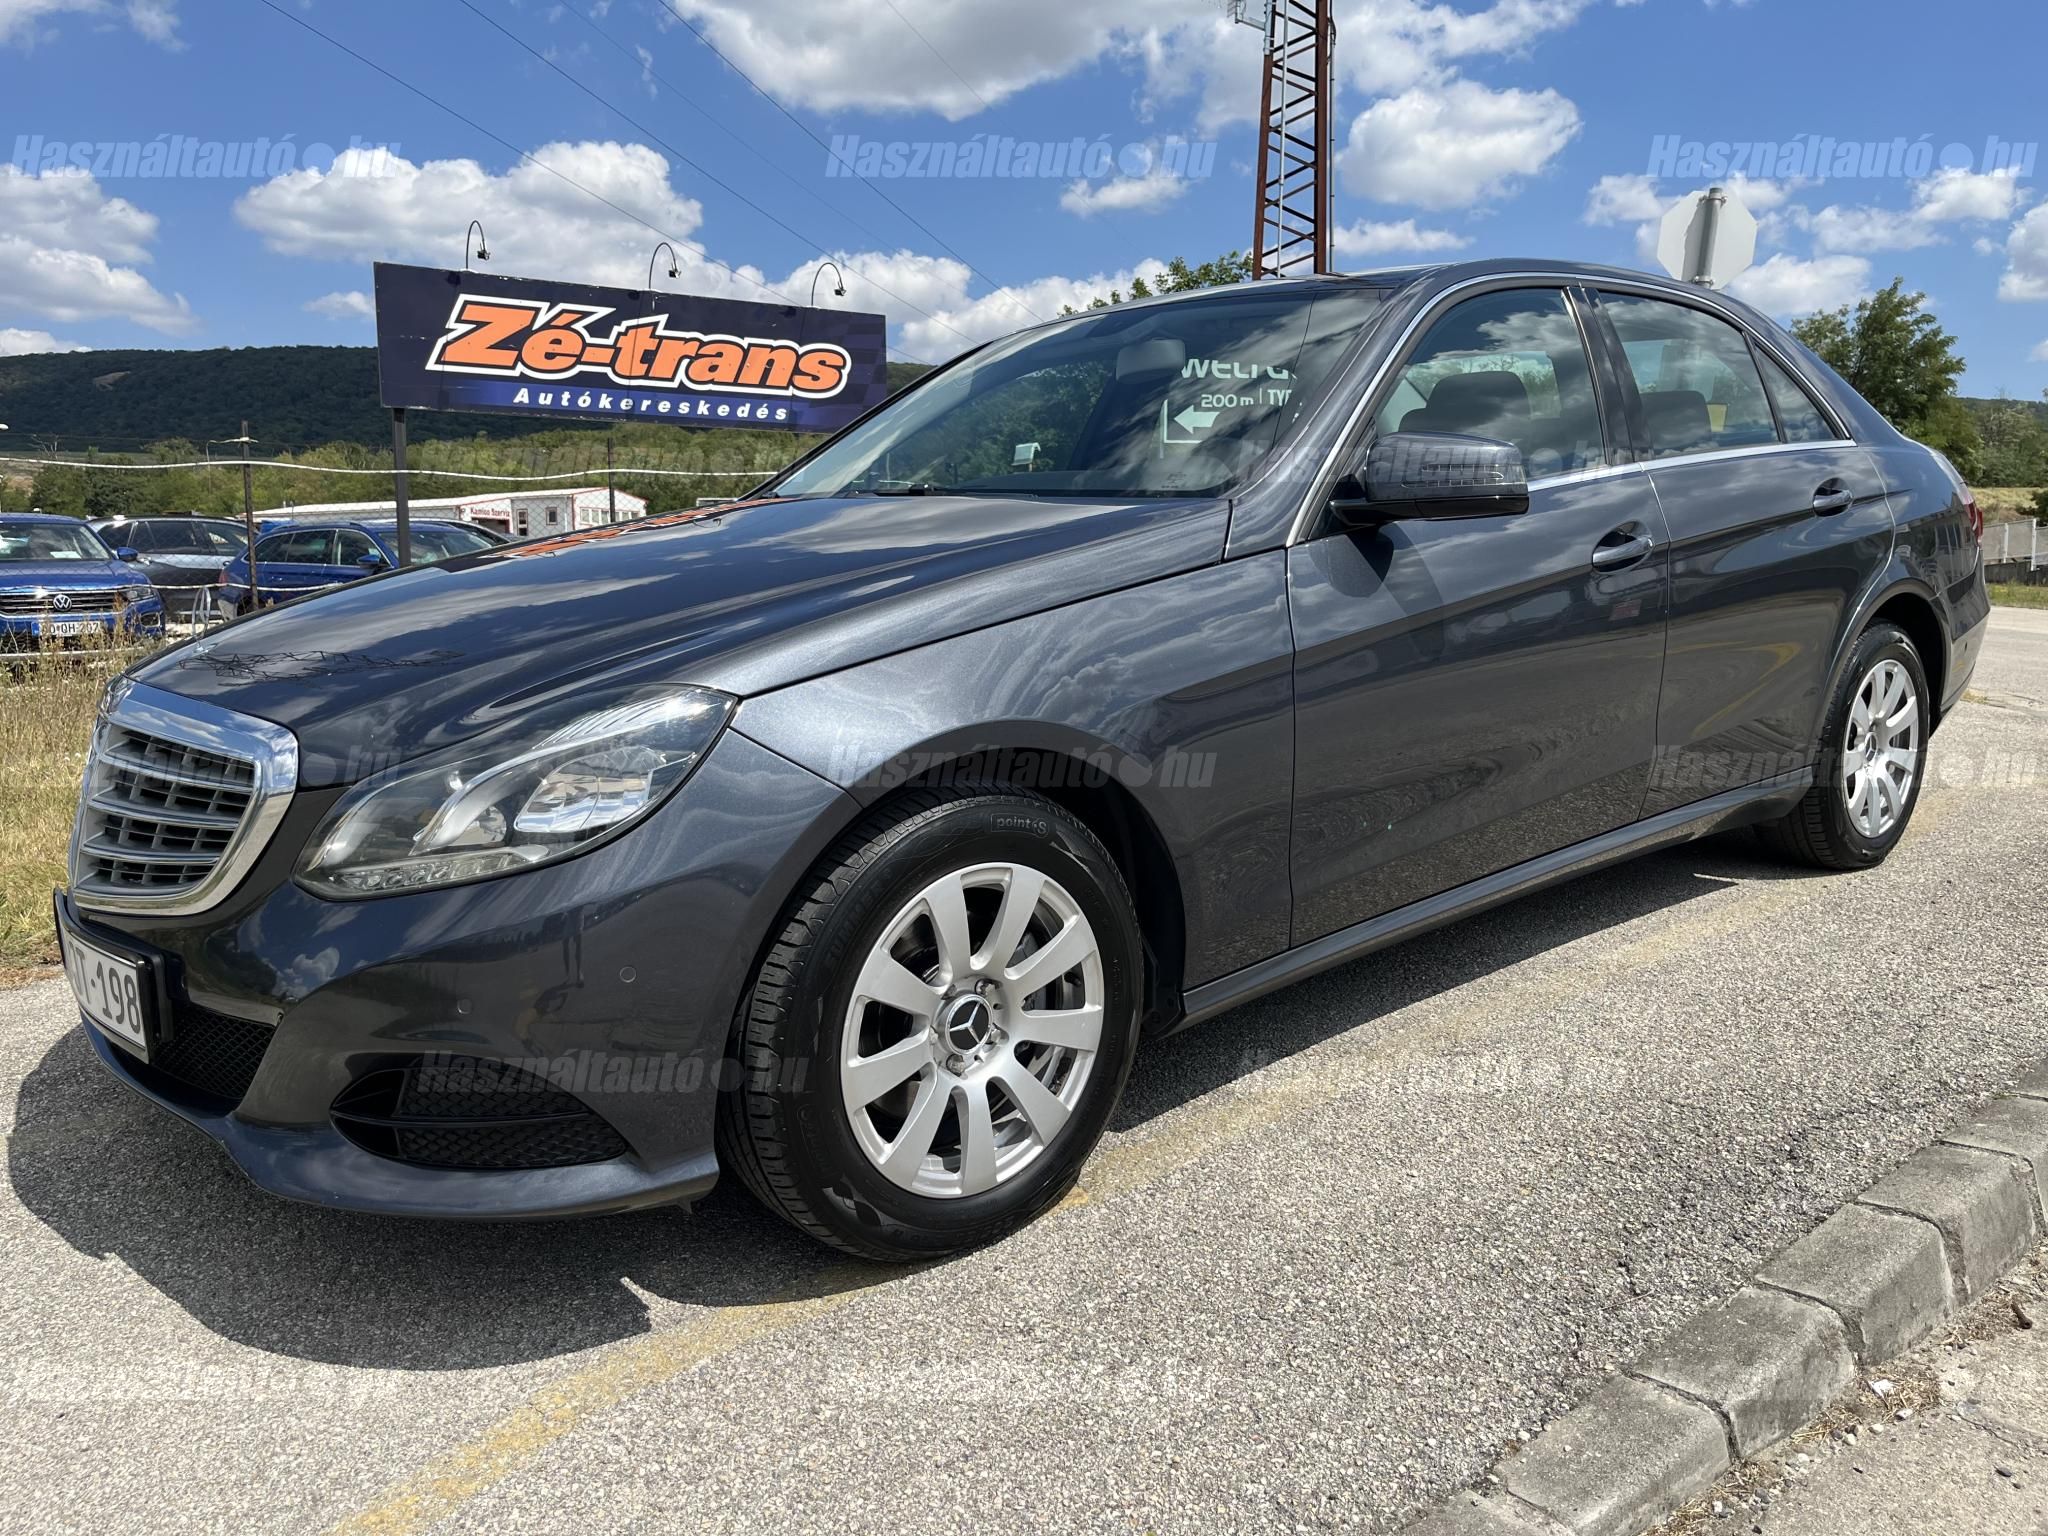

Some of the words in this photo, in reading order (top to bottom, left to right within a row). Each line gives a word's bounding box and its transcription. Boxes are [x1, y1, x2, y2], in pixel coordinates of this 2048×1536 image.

[426, 294, 852, 398] Zé-trans
[513, 387, 788, 421] Autókereskedés
[1201, 393, 1237, 407] 200
[1239, 396, 1254, 406] m
